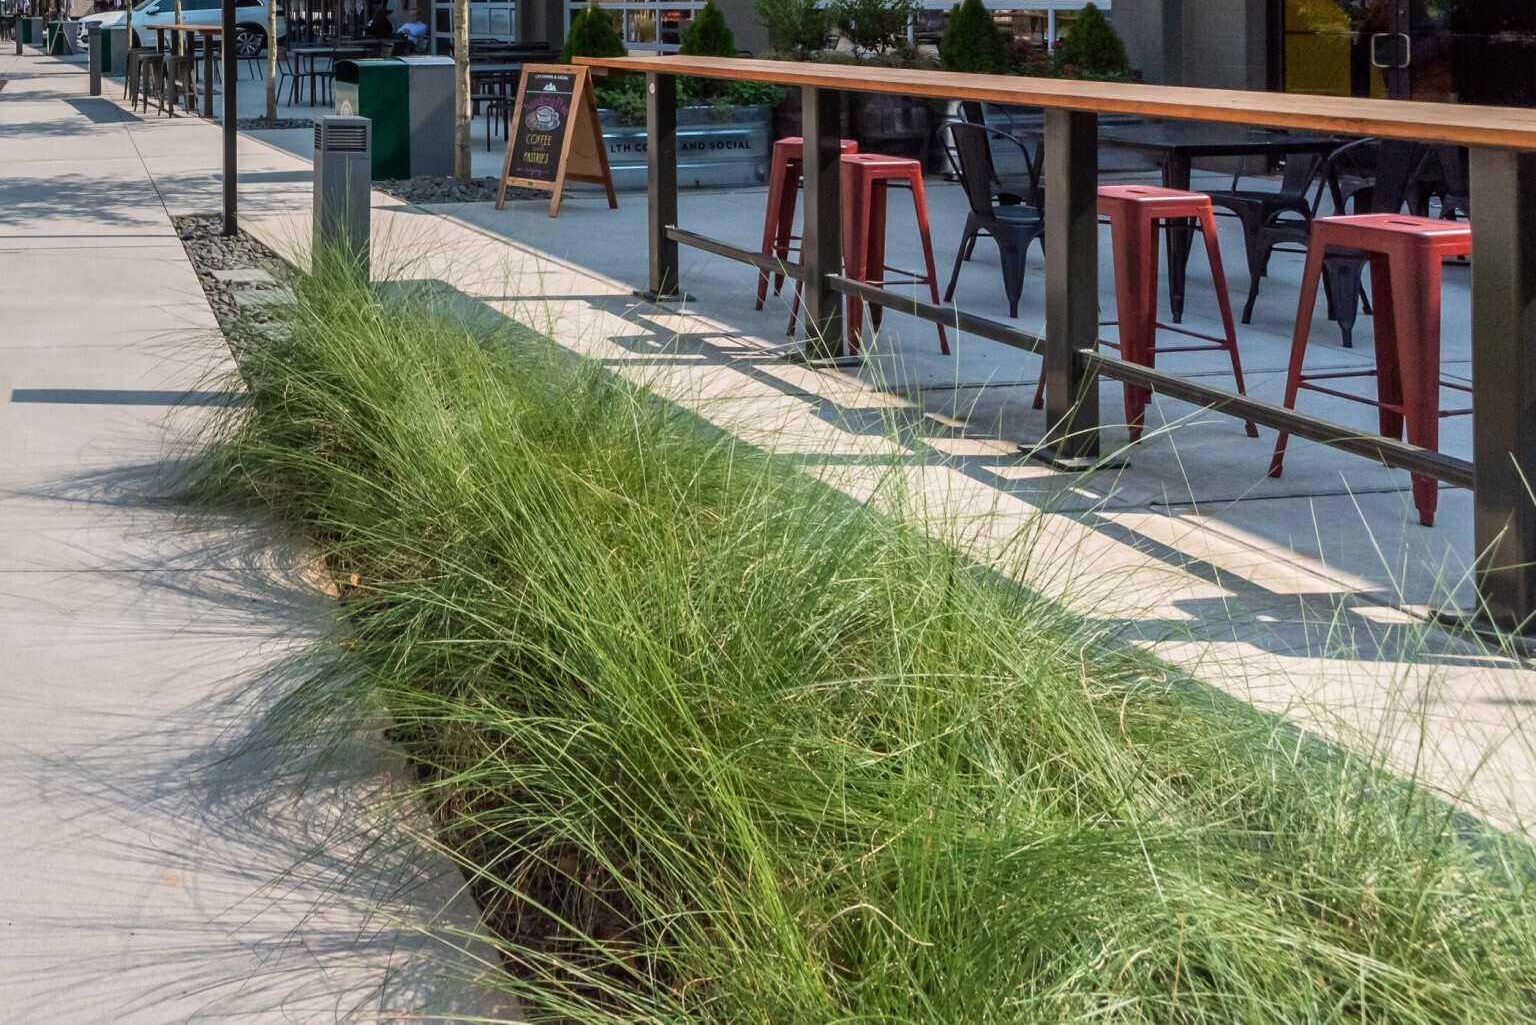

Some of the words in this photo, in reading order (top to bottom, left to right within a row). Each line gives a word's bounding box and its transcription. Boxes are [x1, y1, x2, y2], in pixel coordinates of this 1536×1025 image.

[525, 134, 553, 146] COFFEE
[610, 143, 631, 153] LTH
[681, 141, 705, 151] AND
[709, 140, 751, 150] SOCIAL
